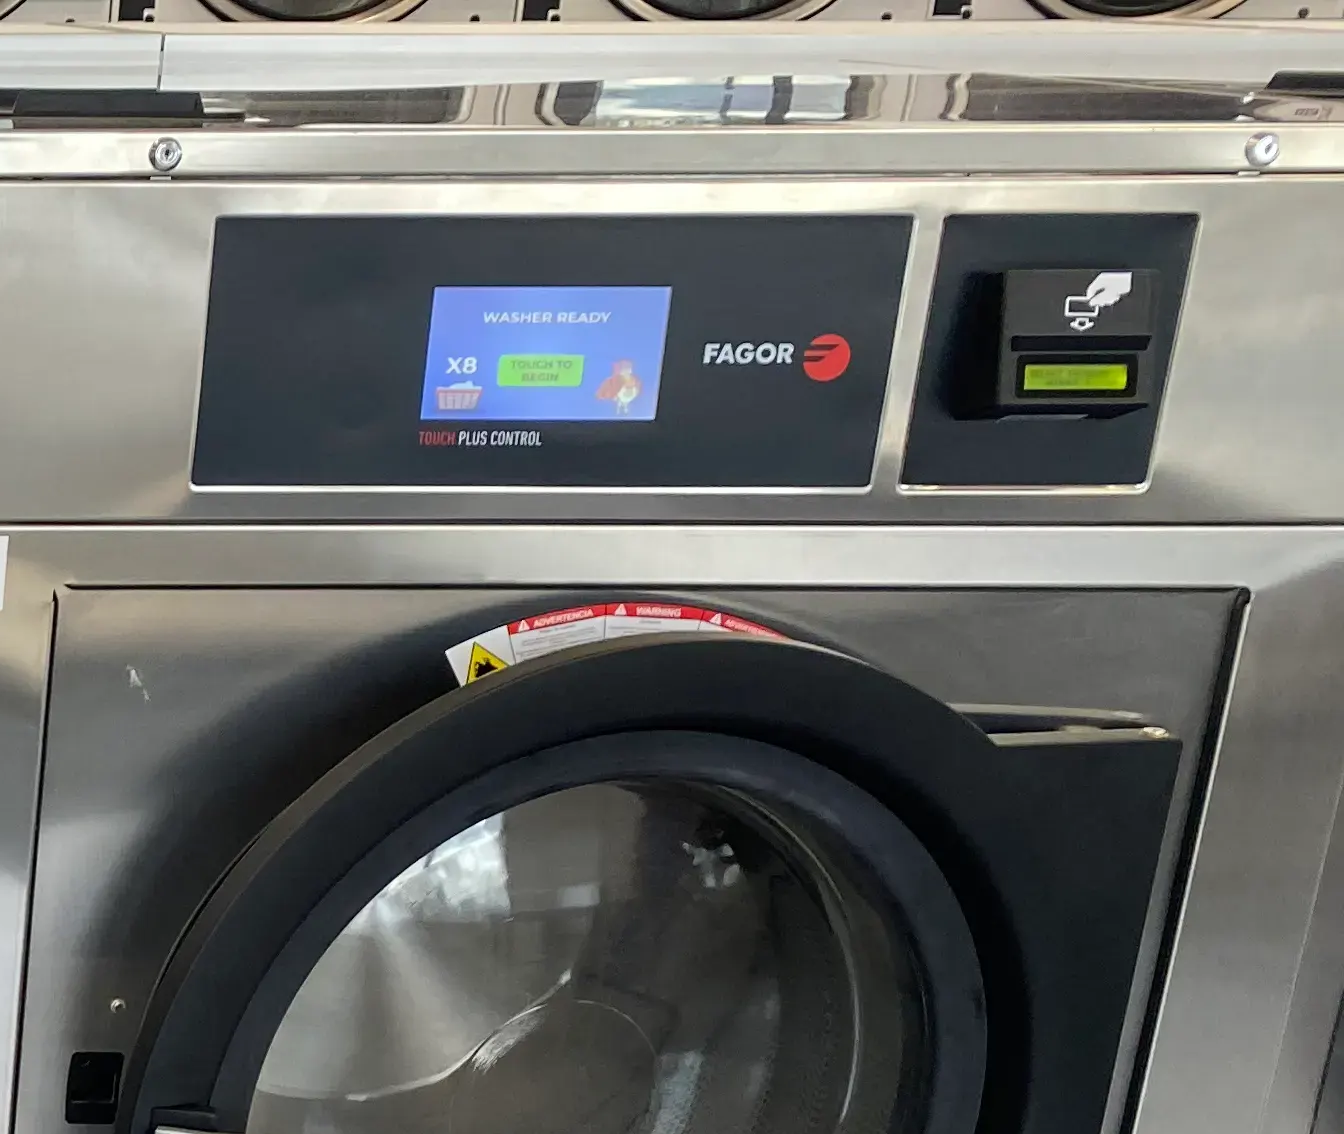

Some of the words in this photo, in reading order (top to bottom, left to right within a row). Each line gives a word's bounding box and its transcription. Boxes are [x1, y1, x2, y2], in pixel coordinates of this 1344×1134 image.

[482, 311, 553, 324] WASHER
[556, 311, 612, 324] READY
[702, 342, 795, 365] FAGOR
[445, 356, 478, 375] X8
[511, 359, 553, 370] TOUCH
[556, 359, 573, 370] TO
[520, 372, 559, 383] BEGIN
[419, 431, 456, 446] TOUCH
[457, 431, 487, 446] PLUS
[489, 431, 543, 447] CONTROL
[636, 606, 682, 618] WARNING
